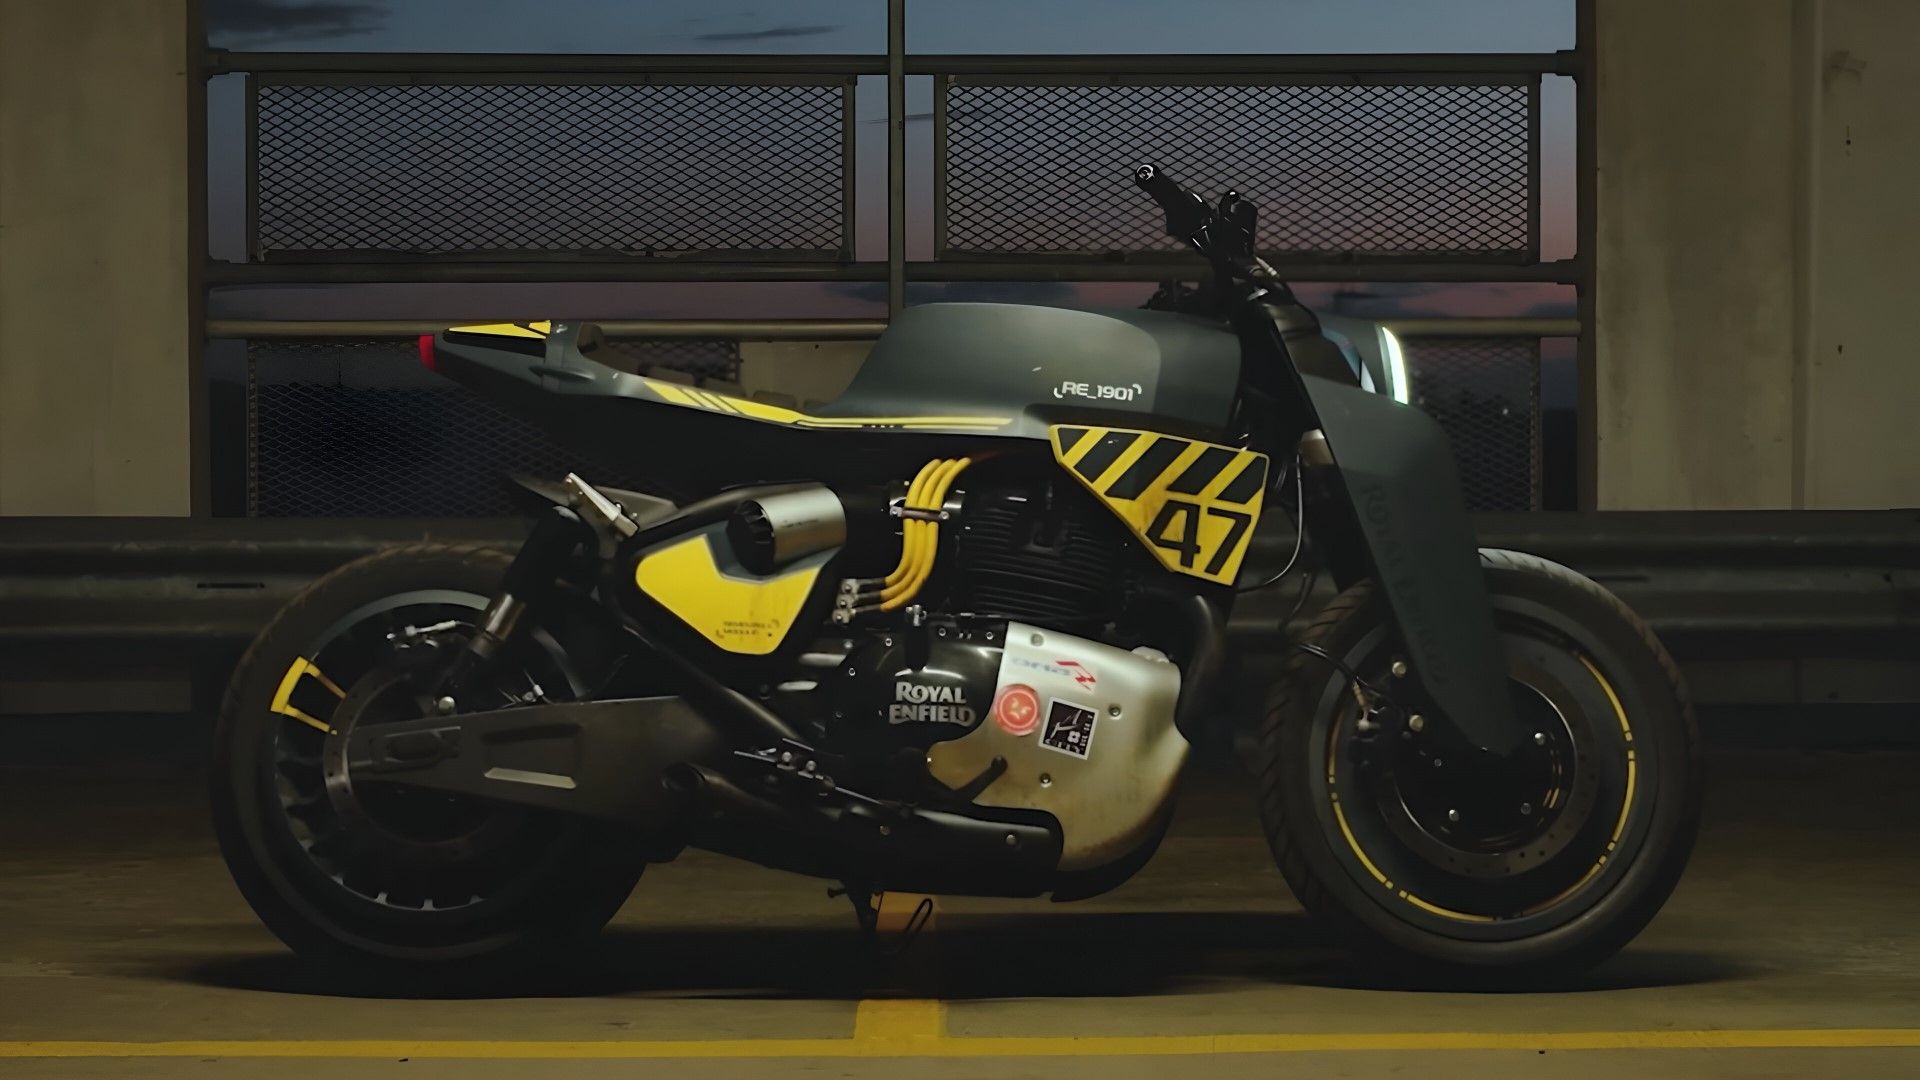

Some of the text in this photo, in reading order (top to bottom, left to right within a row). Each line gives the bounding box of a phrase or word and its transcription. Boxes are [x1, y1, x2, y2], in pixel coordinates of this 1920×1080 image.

[1062, 381, 1134, 402] RE_1901
[1144, 499, 1252, 576] 47
[896, 681, 967, 704] ROYAL
[889, 704, 977, 727] ENFIELD
